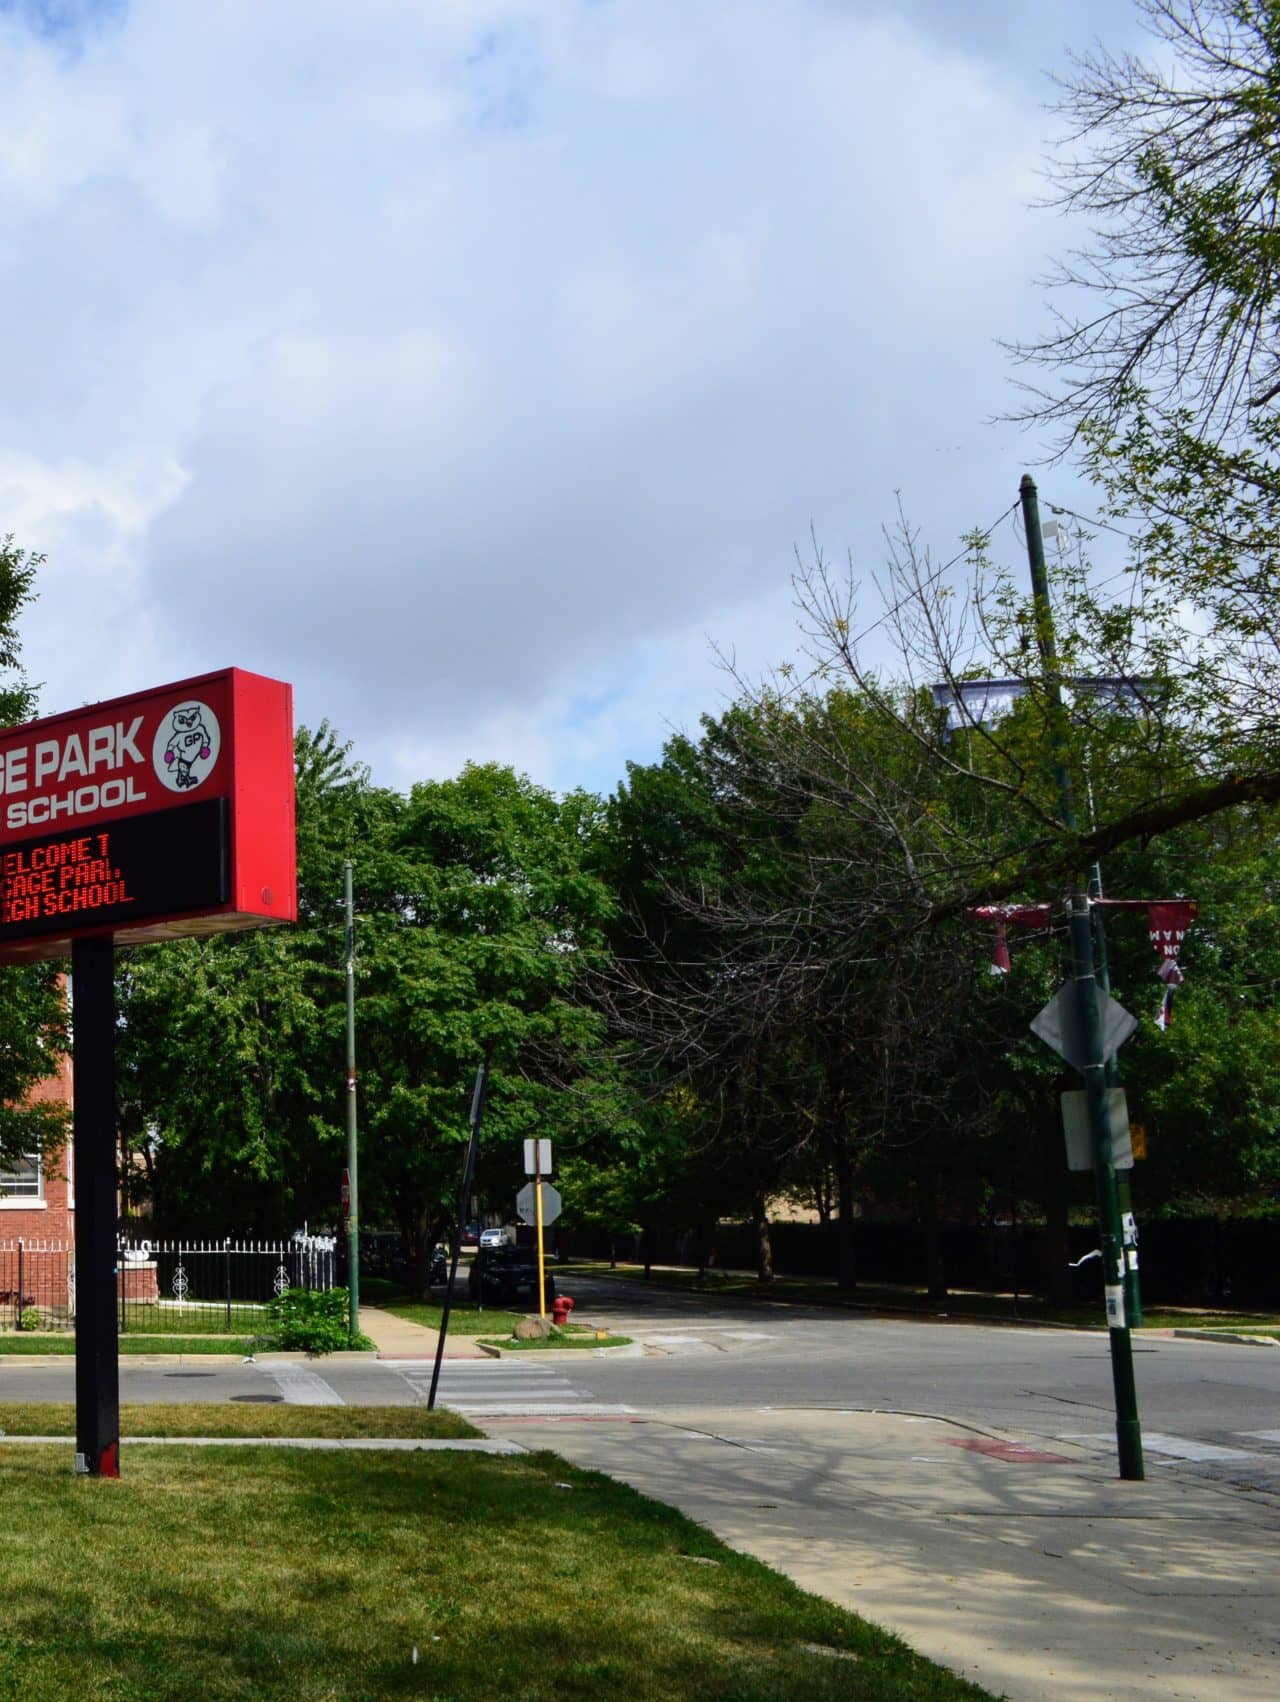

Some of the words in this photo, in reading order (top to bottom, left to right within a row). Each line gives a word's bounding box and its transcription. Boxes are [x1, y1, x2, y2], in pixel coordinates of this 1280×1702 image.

[34, 716, 145, 787] PARK
[184, 732, 202, 747] GP
[6, 776, 146, 829] SCHOOL
[0, 869, 56, 900] GAGE
[43, 880, 135, 916] SCHOOL
